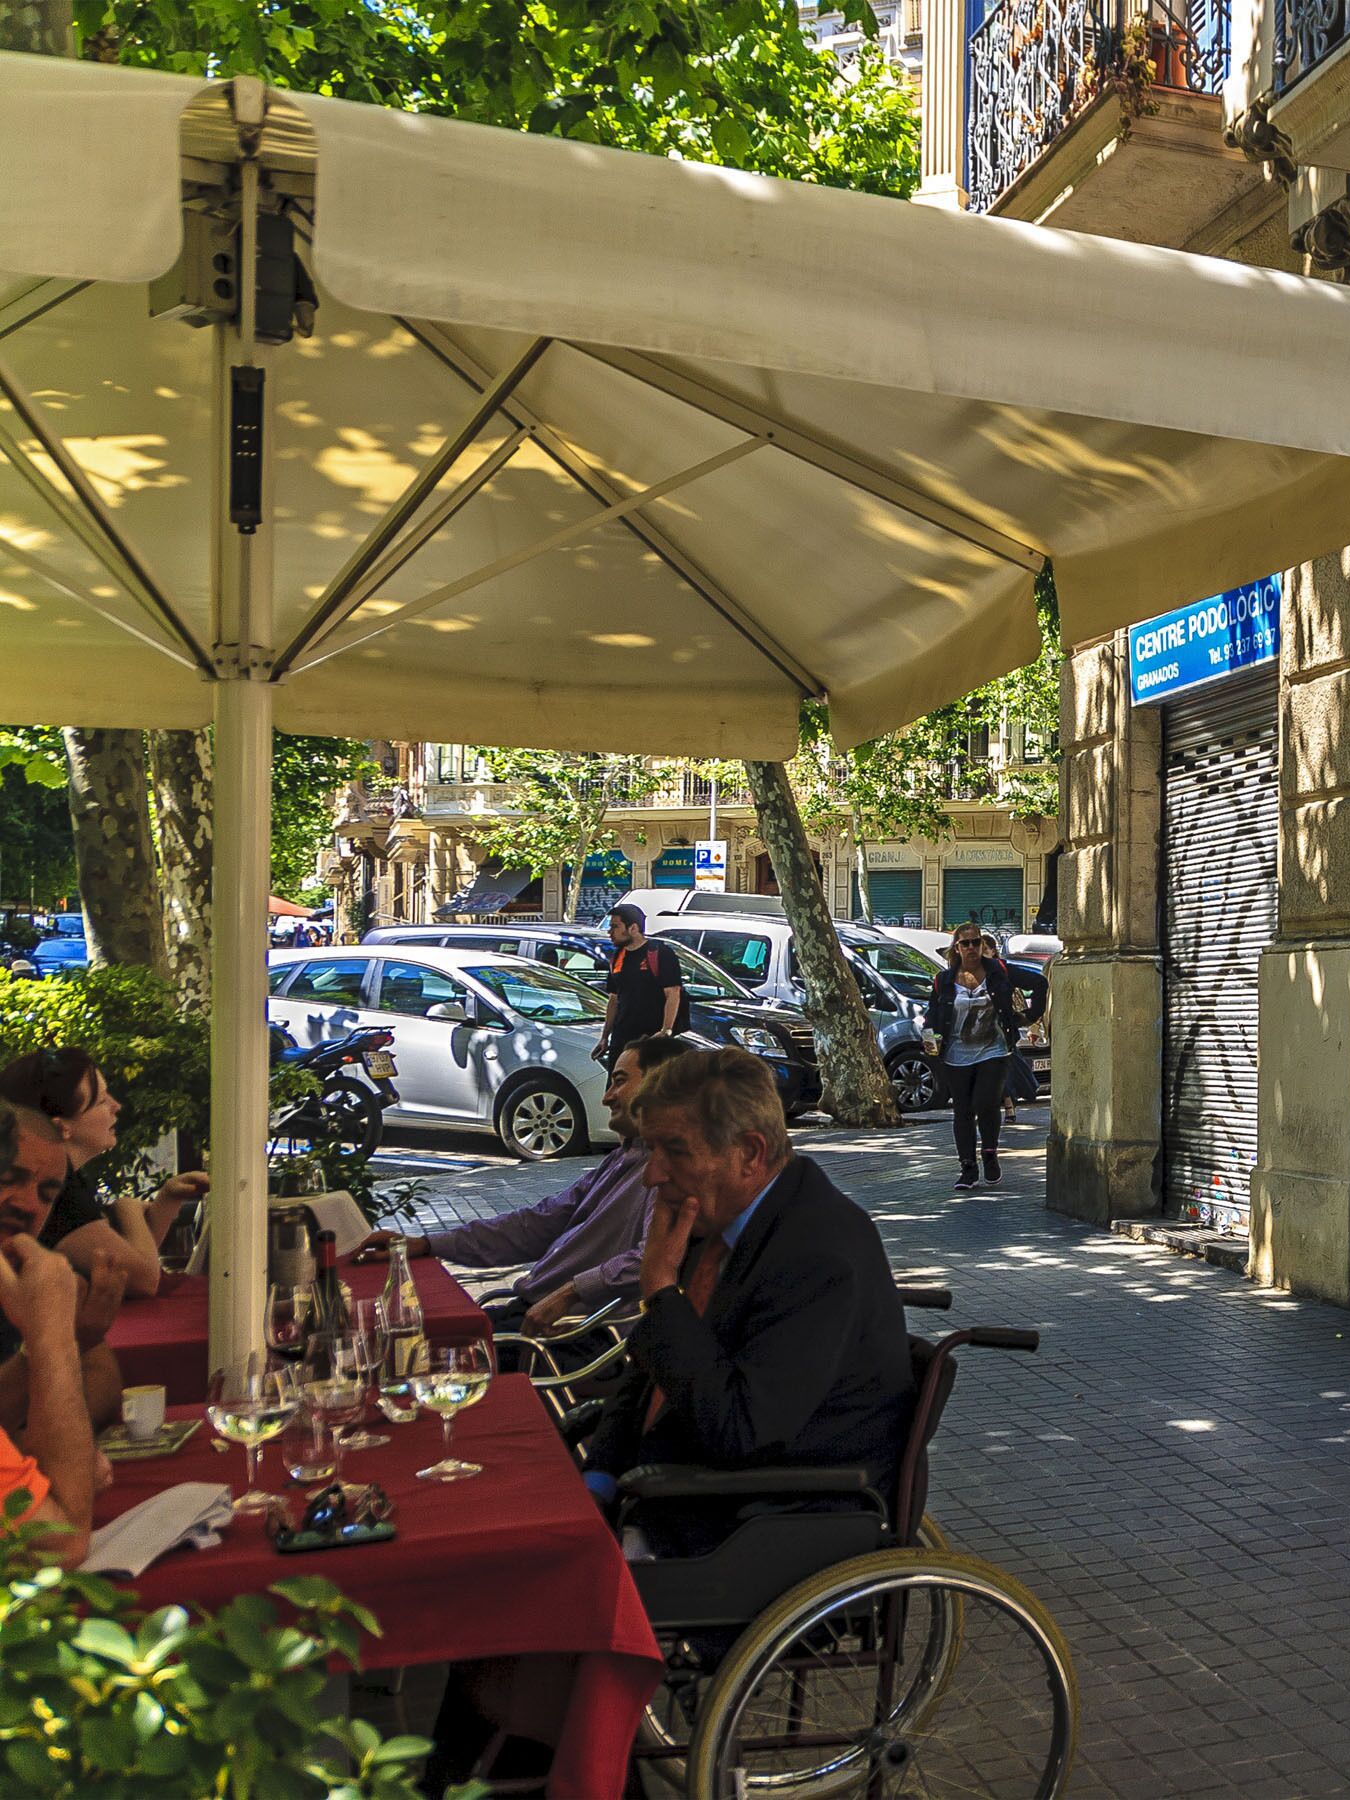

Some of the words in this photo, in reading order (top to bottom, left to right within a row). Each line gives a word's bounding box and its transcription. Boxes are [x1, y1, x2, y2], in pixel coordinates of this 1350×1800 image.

[1136, 619, 1187, 662] CENTRE
[1188, 584, 1275, 642] PODOLÒGIC
[1208, 648, 1223, 665] Tel.
[1224, 643, 1234, 660] 93
[1236, 637, 1250, 656] 237
[1253, 632, 1264, 649] 69
[1265, 628, 1276, 646] 37
[1137, 662, 1179, 692] GRANADOS
[699, 851, 708, 862] P
